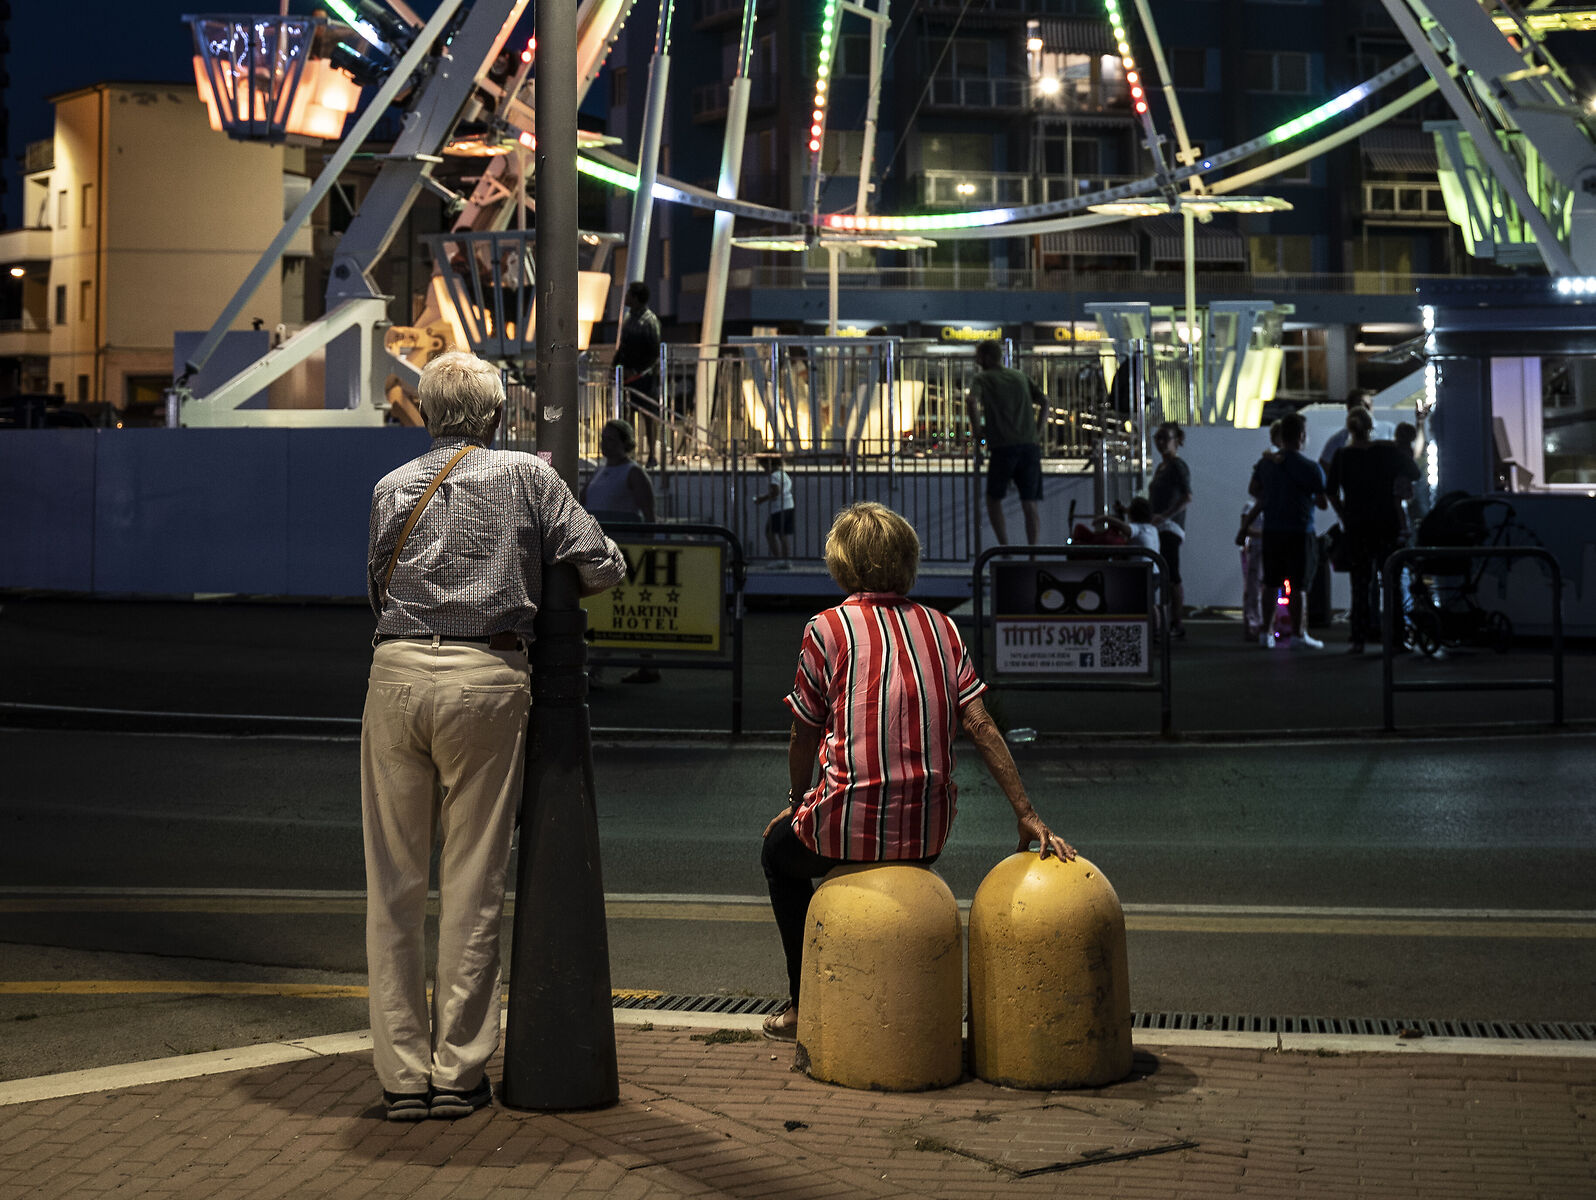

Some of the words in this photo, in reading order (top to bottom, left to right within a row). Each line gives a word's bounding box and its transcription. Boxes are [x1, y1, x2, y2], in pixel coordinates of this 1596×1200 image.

[613, 605, 678, 619] MARTINI
[613, 617, 678, 631] HOTEL
[1003, 625, 1055, 646] TITTI'S
[1058, 625, 1095, 646] SHOP
